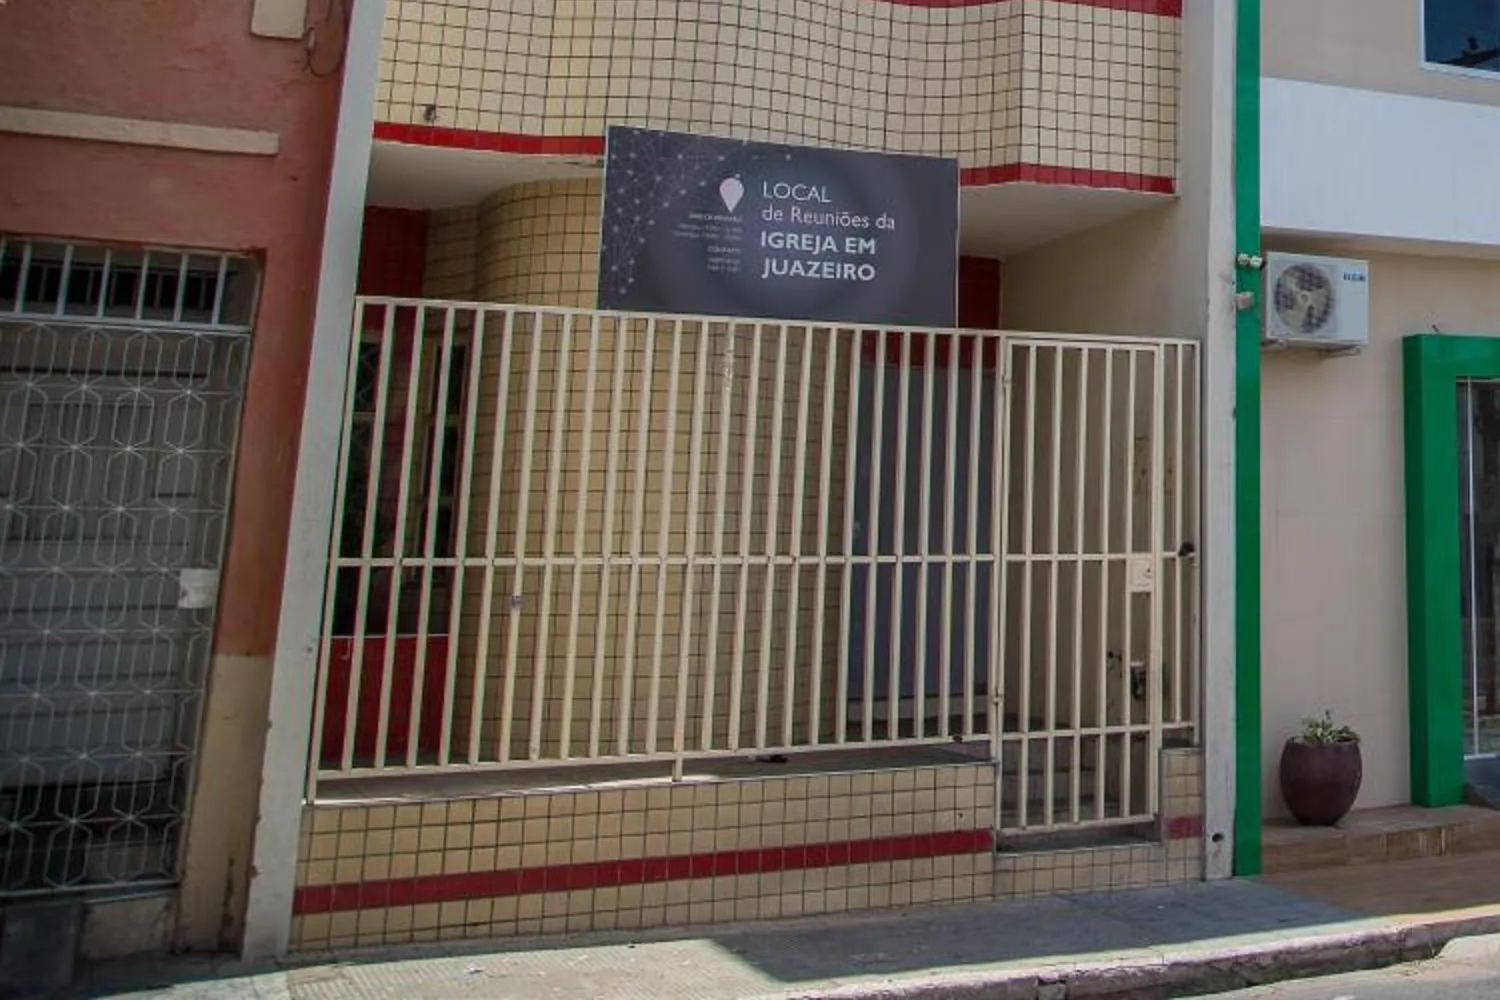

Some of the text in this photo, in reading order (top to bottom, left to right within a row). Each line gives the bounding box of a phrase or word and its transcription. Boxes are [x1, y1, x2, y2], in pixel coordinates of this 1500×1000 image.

[763, 180, 832, 203] LOCAL
[762, 203, 784, 222] de
[790, 205, 870, 229] Reuniões
[875, 212, 896, 230] da
[761, 230, 839, 255] IGREJA
[845, 236, 876, 255] EM
[762, 257, 876, 281] JUAZEIRO
